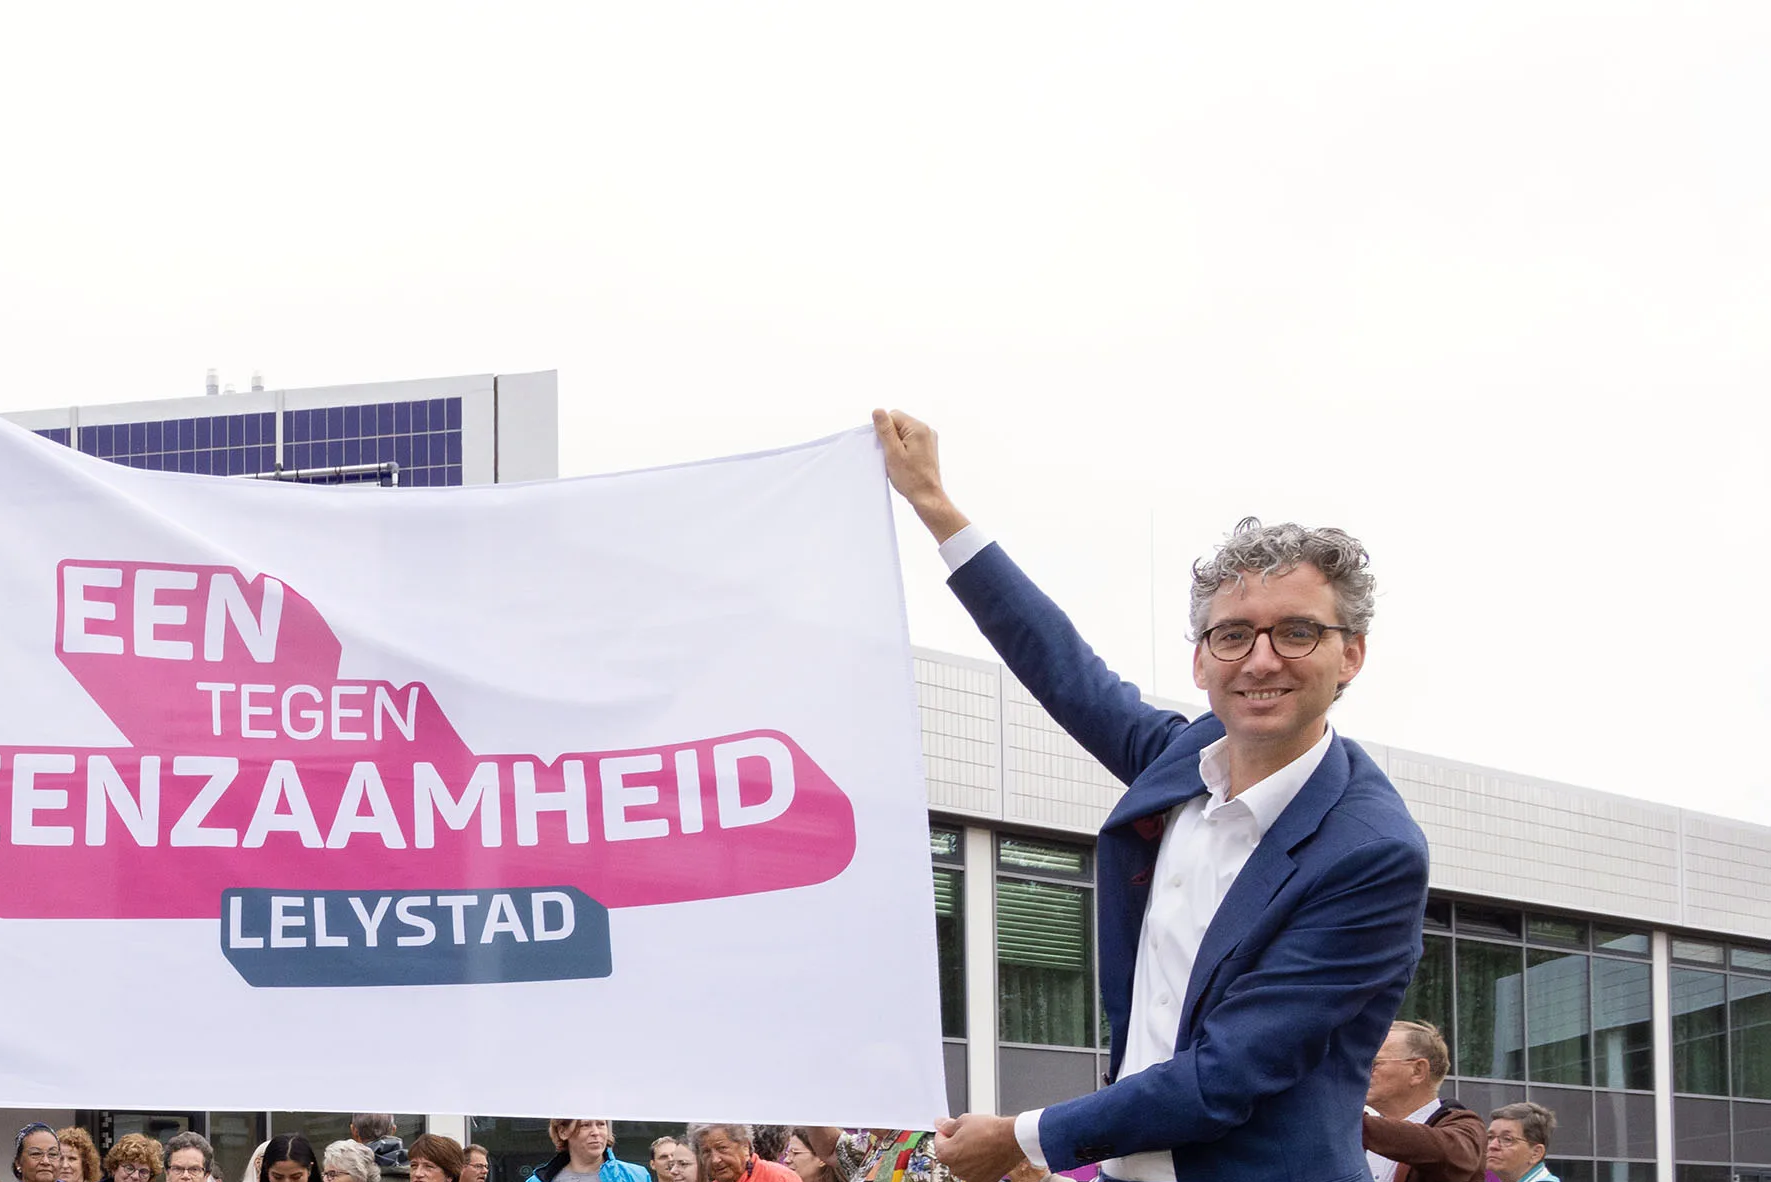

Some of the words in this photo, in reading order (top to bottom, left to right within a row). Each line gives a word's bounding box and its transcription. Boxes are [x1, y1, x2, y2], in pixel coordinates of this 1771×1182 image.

[61, 565, 285, 664] EEN
[196, 680, 420, 743] TEGEN
[227, 889, 577, 951] LELYSTAD
